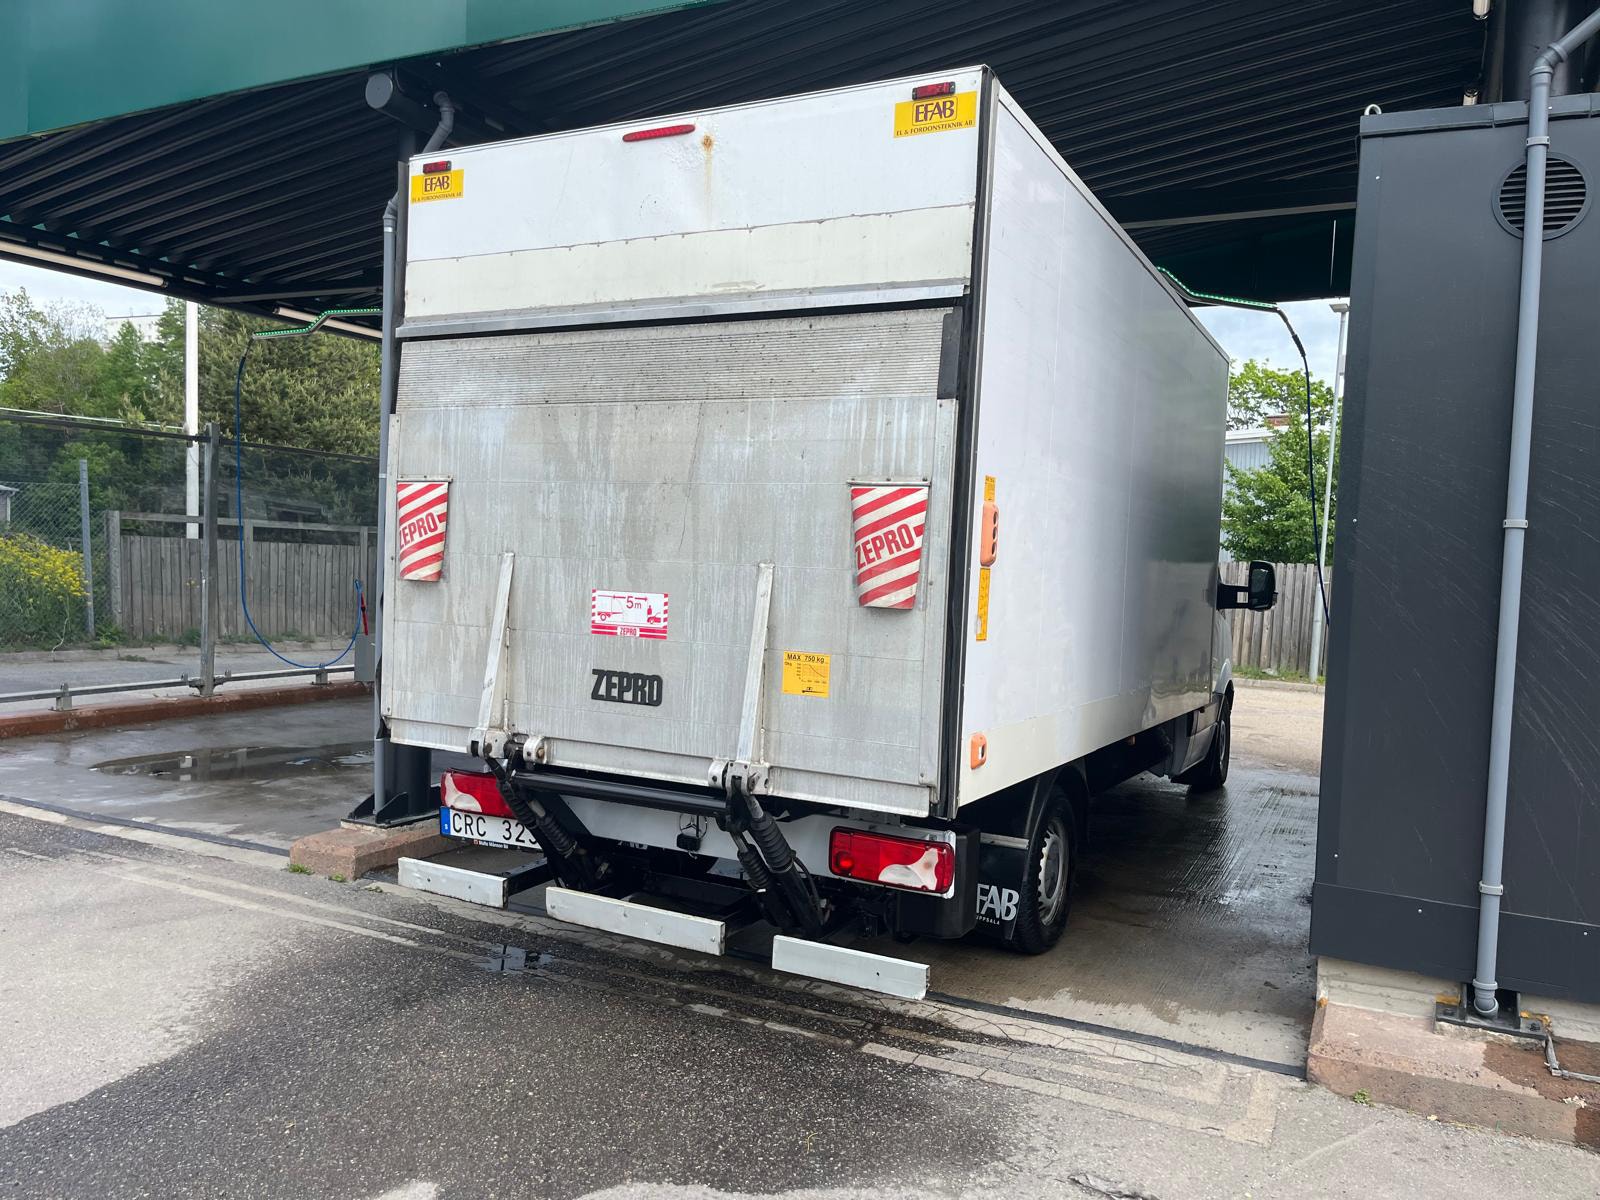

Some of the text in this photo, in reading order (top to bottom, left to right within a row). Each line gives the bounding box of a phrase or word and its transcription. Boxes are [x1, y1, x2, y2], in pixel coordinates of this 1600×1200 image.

[915, 100, 955, 123] EFAB
[910, 121, 963, 134] FORDONSTEKNIK
[424, 175, 450, 193] EFAB
[855, 523, 915, 570] ZEPRO
[619, 626, 638, 637] ZEPRO
[787, 653, 802, 661] MAX
[816, 656, 825, 664] kg
[590, 668, 664, 707] ZEPRO
[452, 813, 487, 837] CRC
